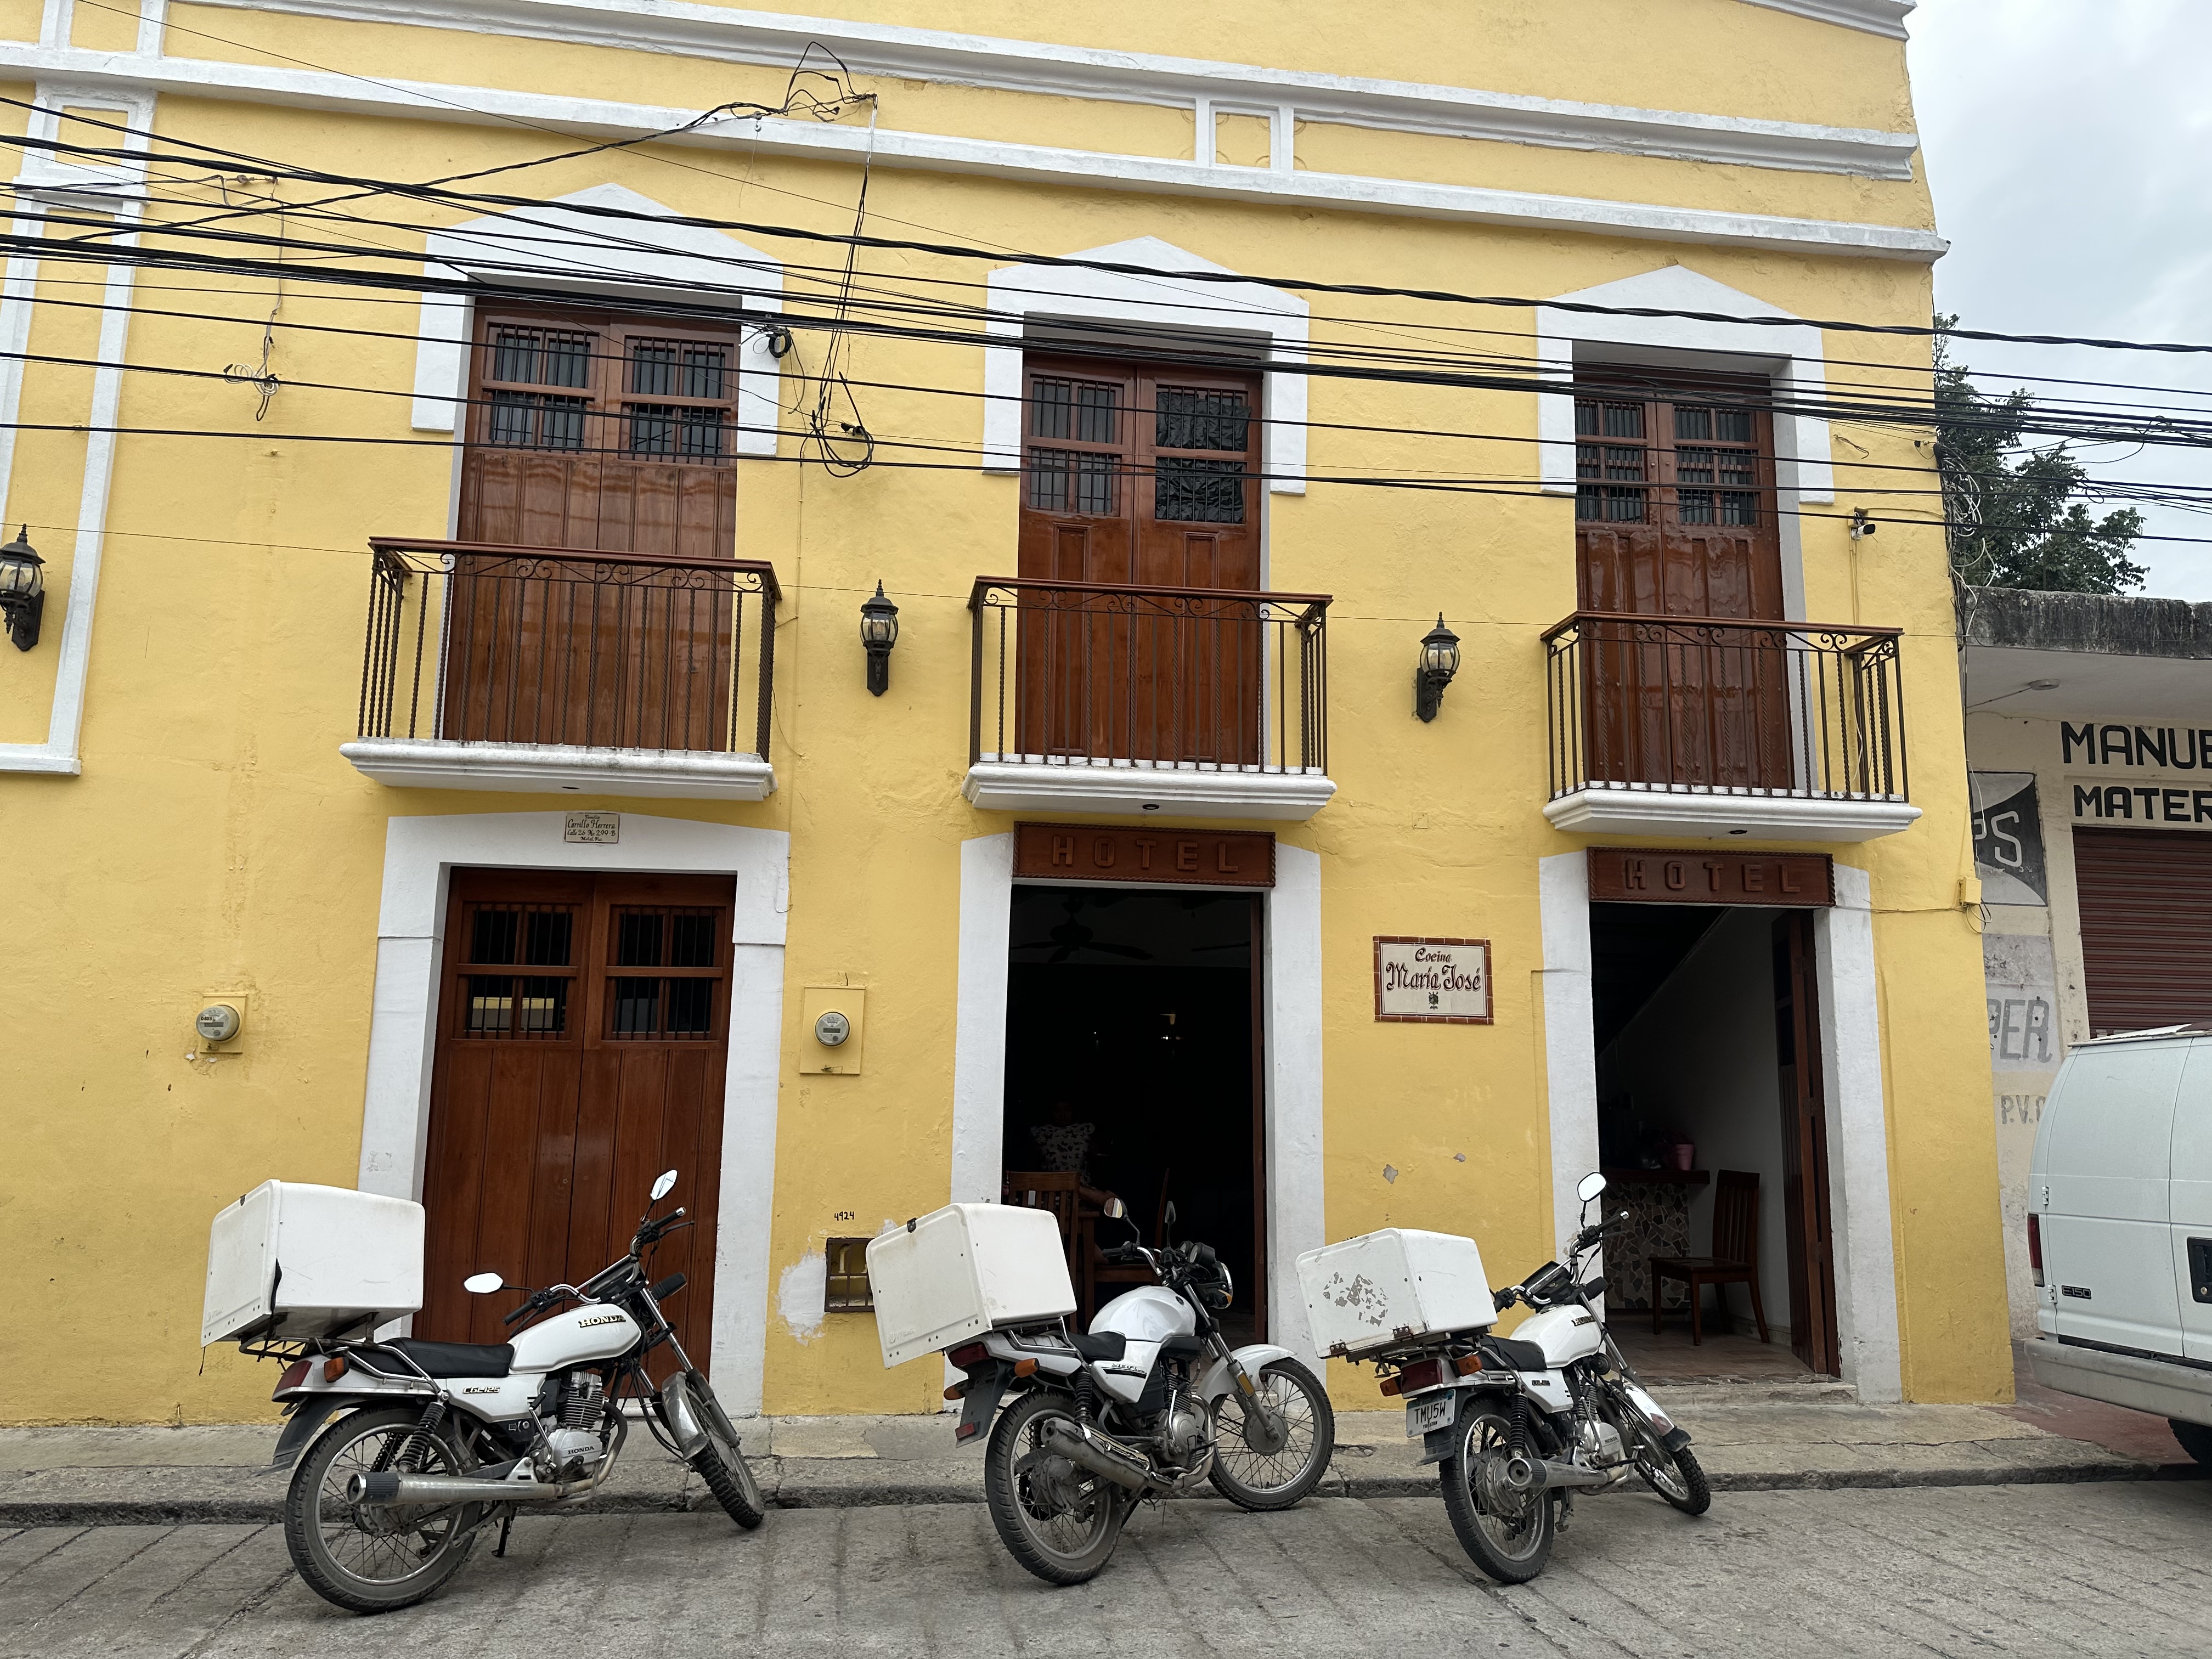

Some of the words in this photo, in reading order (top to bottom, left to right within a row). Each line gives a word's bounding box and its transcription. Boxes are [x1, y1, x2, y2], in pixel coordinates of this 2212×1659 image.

[2074, 785, 2212, 823] MATER
[591, 820, 616, 829] Herrera
[1052, 836, 1238, 873] HOTEL
[1626, 859, 1801, 893] HOTEL
[1415, 947, 1452, 962] Cocina
[1442, 964, 1481, 991] José
[834, 1211, 855, 1221] 4924
[579, 1315, 626, 1328] HONDA
[567, 1446, 595, 1454] HONDA
